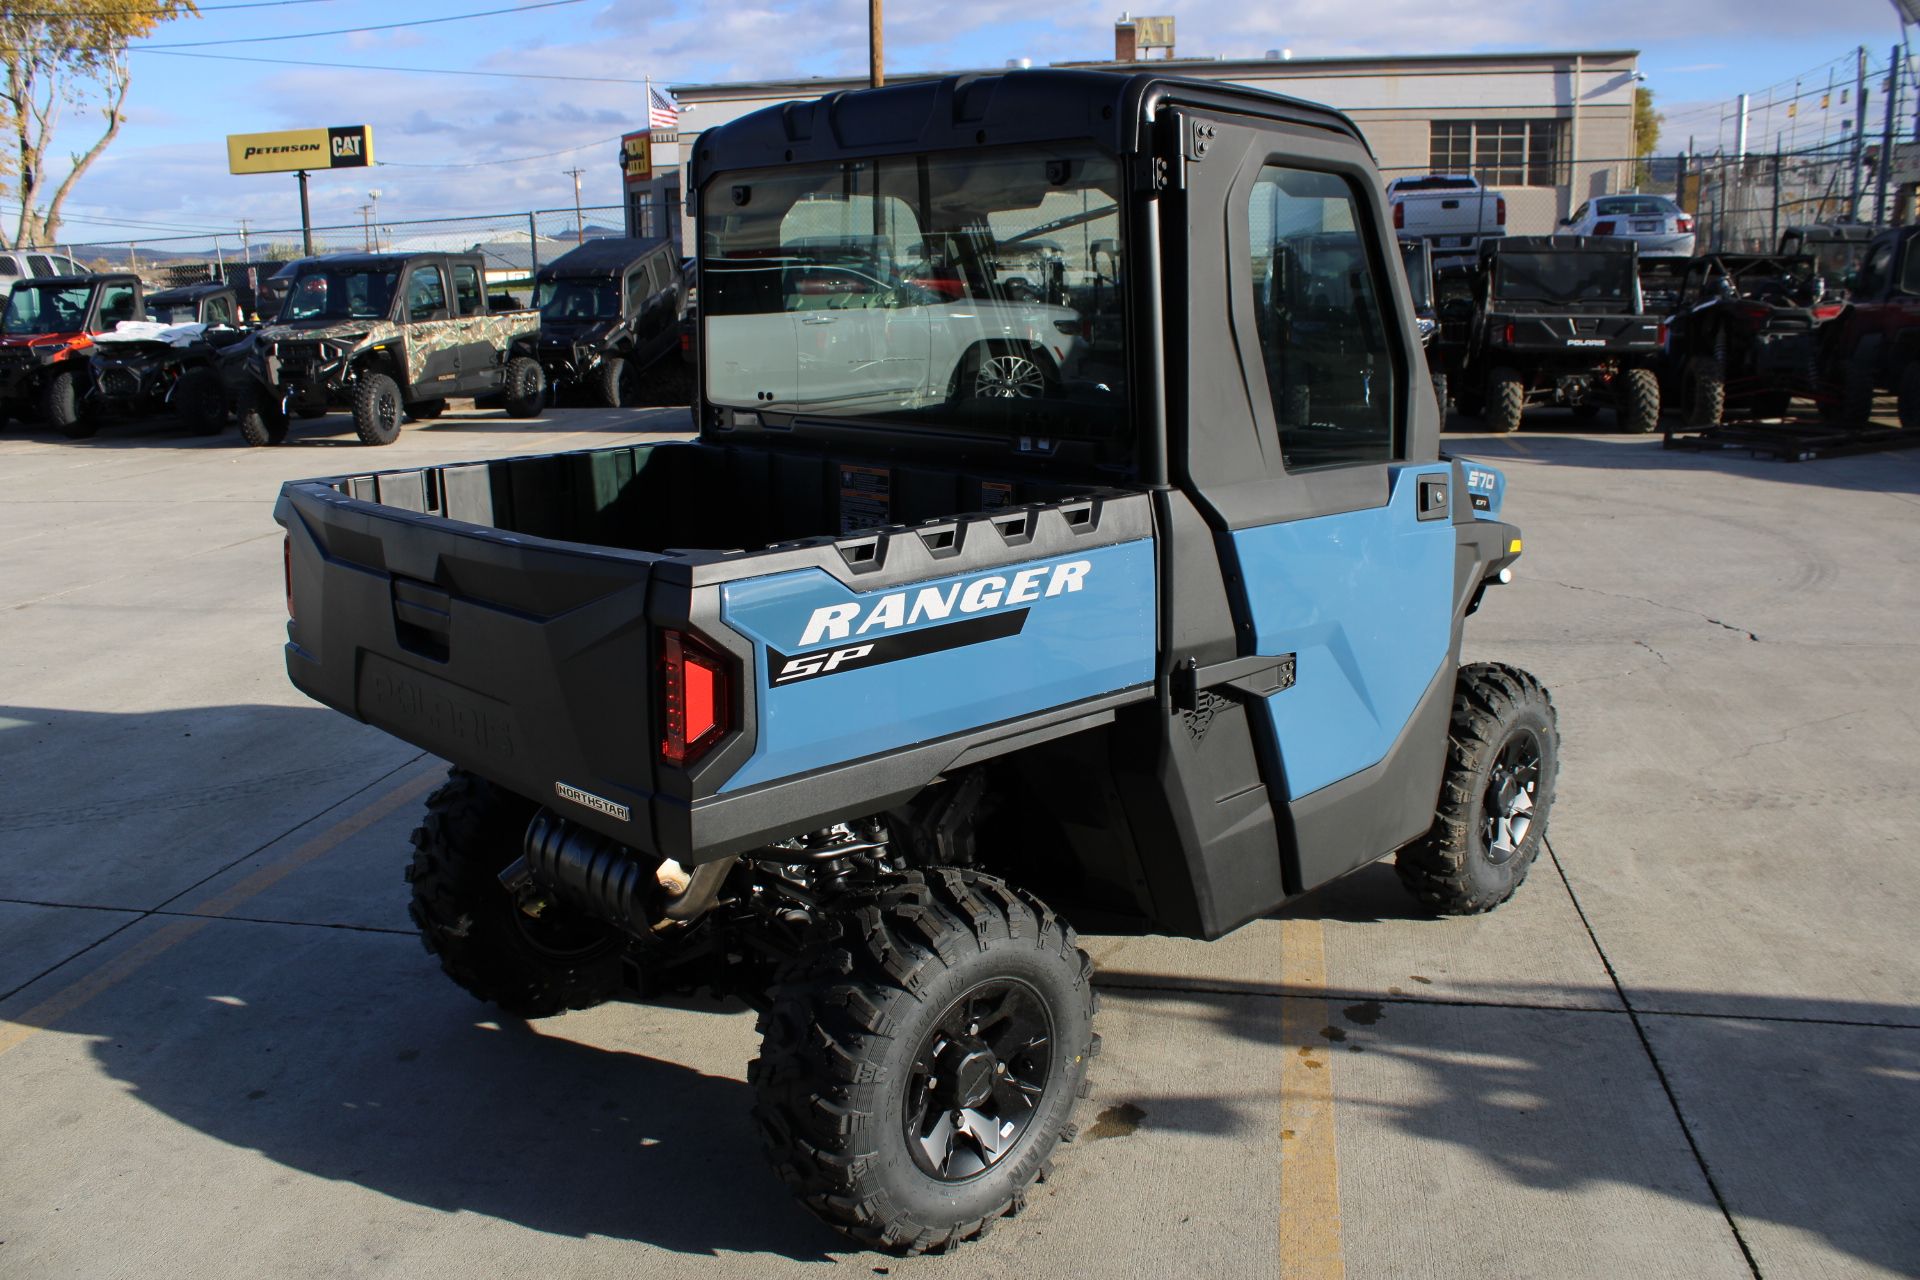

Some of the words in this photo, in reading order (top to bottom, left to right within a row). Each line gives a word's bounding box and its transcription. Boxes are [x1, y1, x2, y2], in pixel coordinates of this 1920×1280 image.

[1138, 18, 1173, 43] AT
[244, 143, 320, 159] PETERSON
[332, 135, 361, 157] CAT
[1566, 339, 1606, 347] POLARIS
[797, 559, 1092, 647] RANGER
[775, 642, 875, 682] SP
[559, 784, 625, 818] NORTHSTAR
